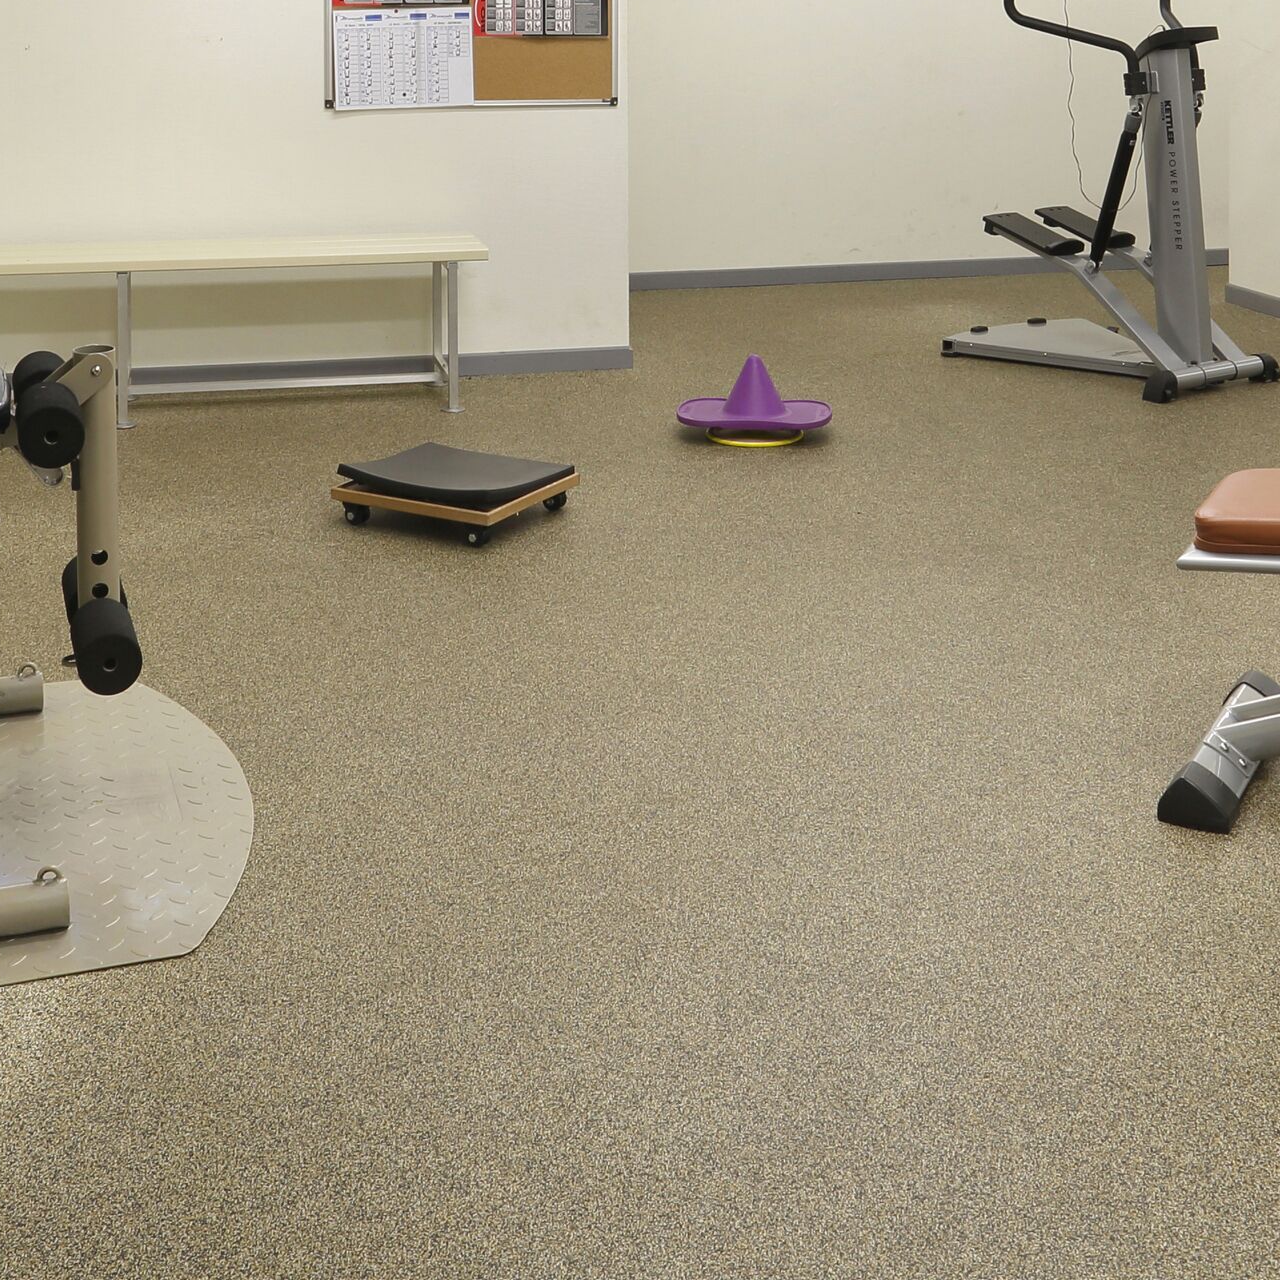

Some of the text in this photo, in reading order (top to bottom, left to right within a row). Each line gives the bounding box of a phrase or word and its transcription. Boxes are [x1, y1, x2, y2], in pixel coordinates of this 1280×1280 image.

[1164, 100, 1183, 251] KETTLER POWER STEPPER
